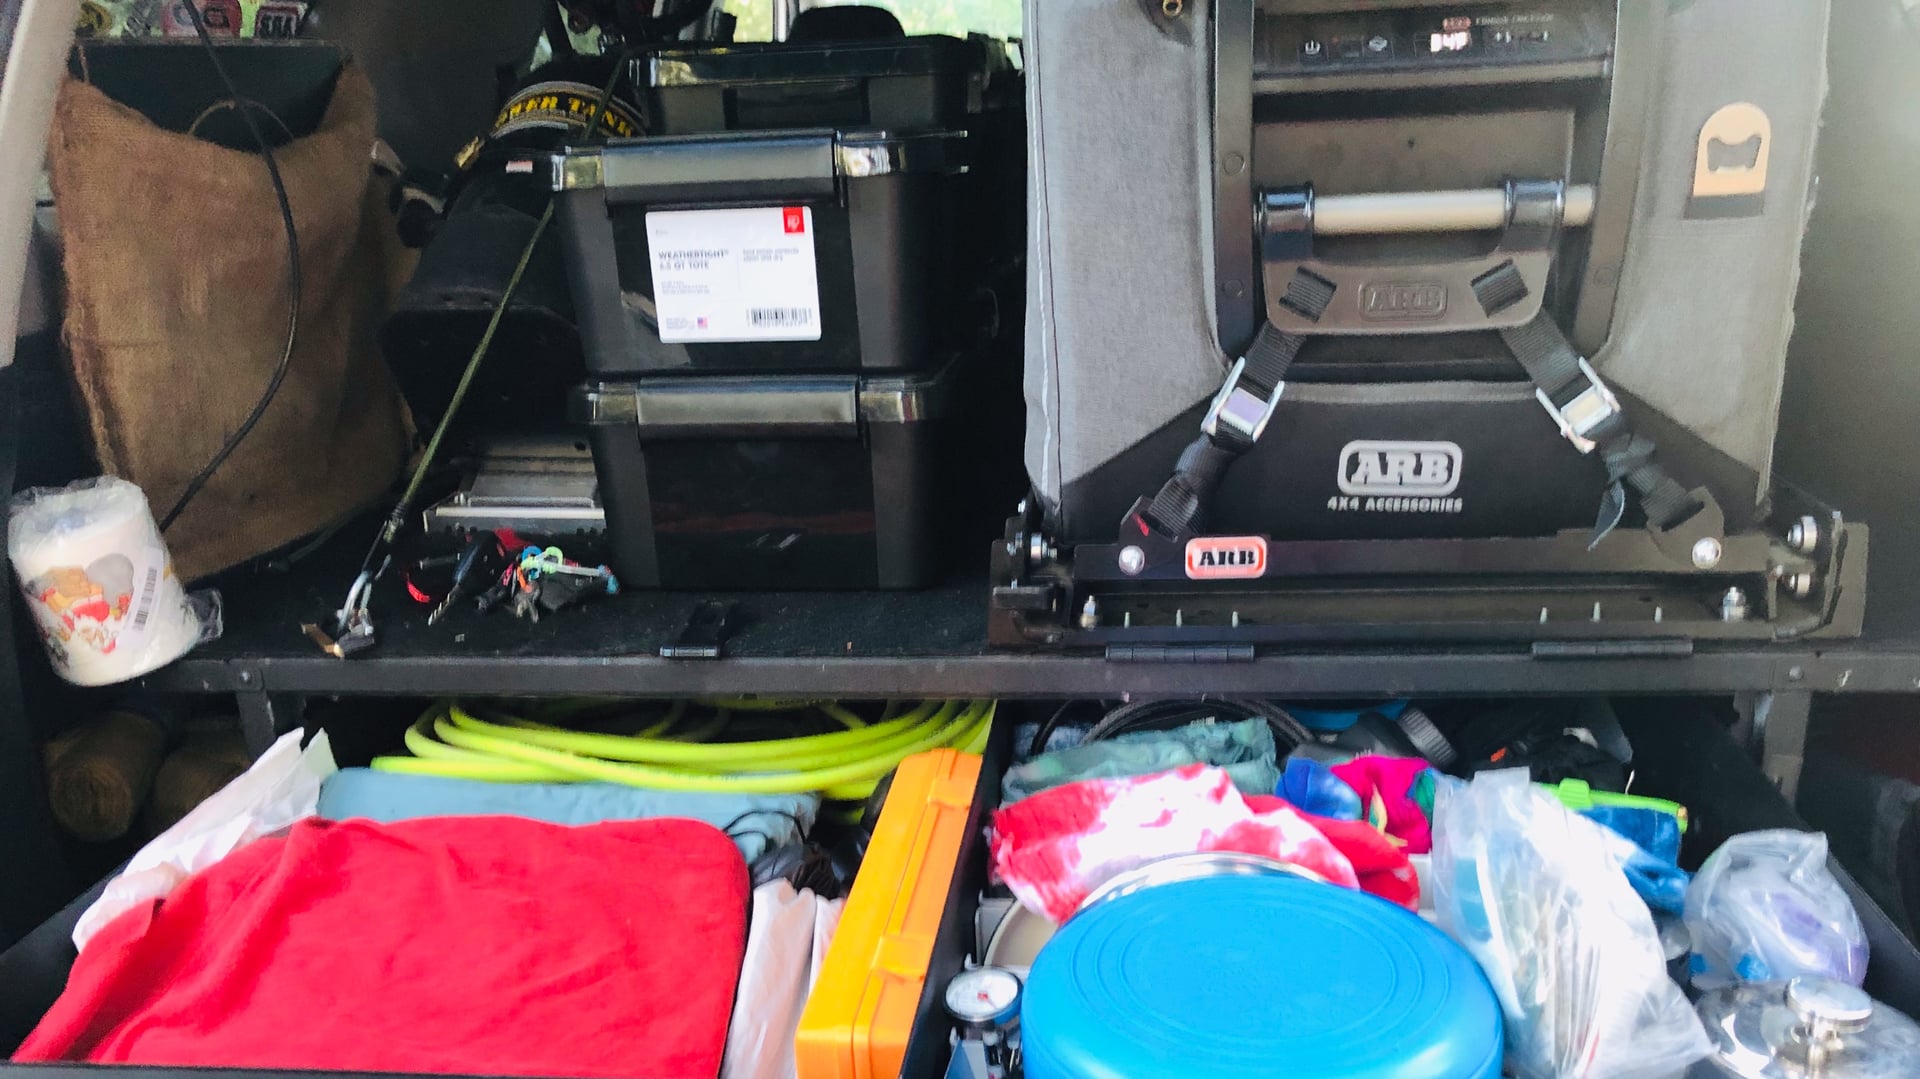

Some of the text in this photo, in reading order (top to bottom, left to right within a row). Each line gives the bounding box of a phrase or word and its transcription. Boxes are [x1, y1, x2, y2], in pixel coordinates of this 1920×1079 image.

[1350, 451, 1450, 485] ARB
[1364, 497, 1463, 513] ACCESSORIES
[1198, 548, 1256, 567] ARB
